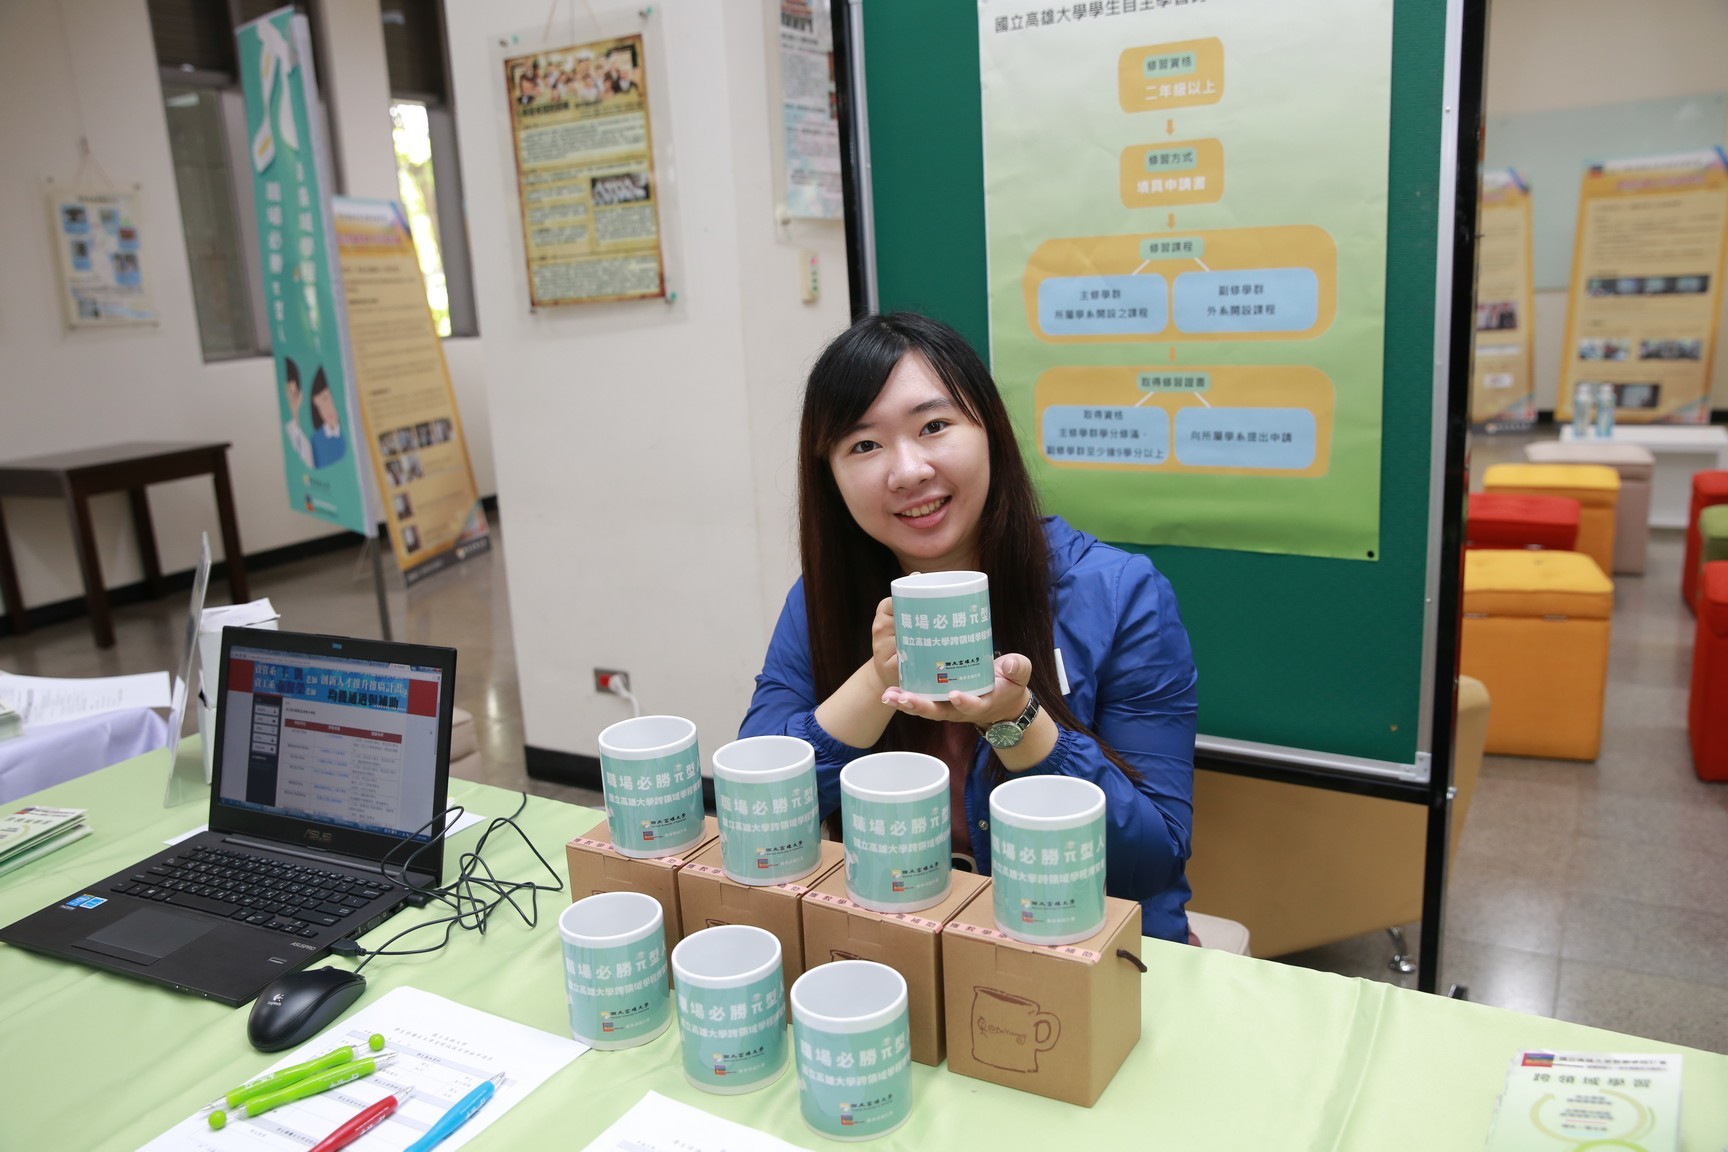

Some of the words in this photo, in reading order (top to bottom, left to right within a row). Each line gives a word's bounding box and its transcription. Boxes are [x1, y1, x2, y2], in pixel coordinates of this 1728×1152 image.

[1144, 80, 1216, 100] 二年級以上
[1148, 150, 1194, 166] 修習方式
[1149, 241, 1193, 255] 修習課程
[1218, 284, 1265, 296] 副修學群
[303, 828, 333, 843] ASUS
